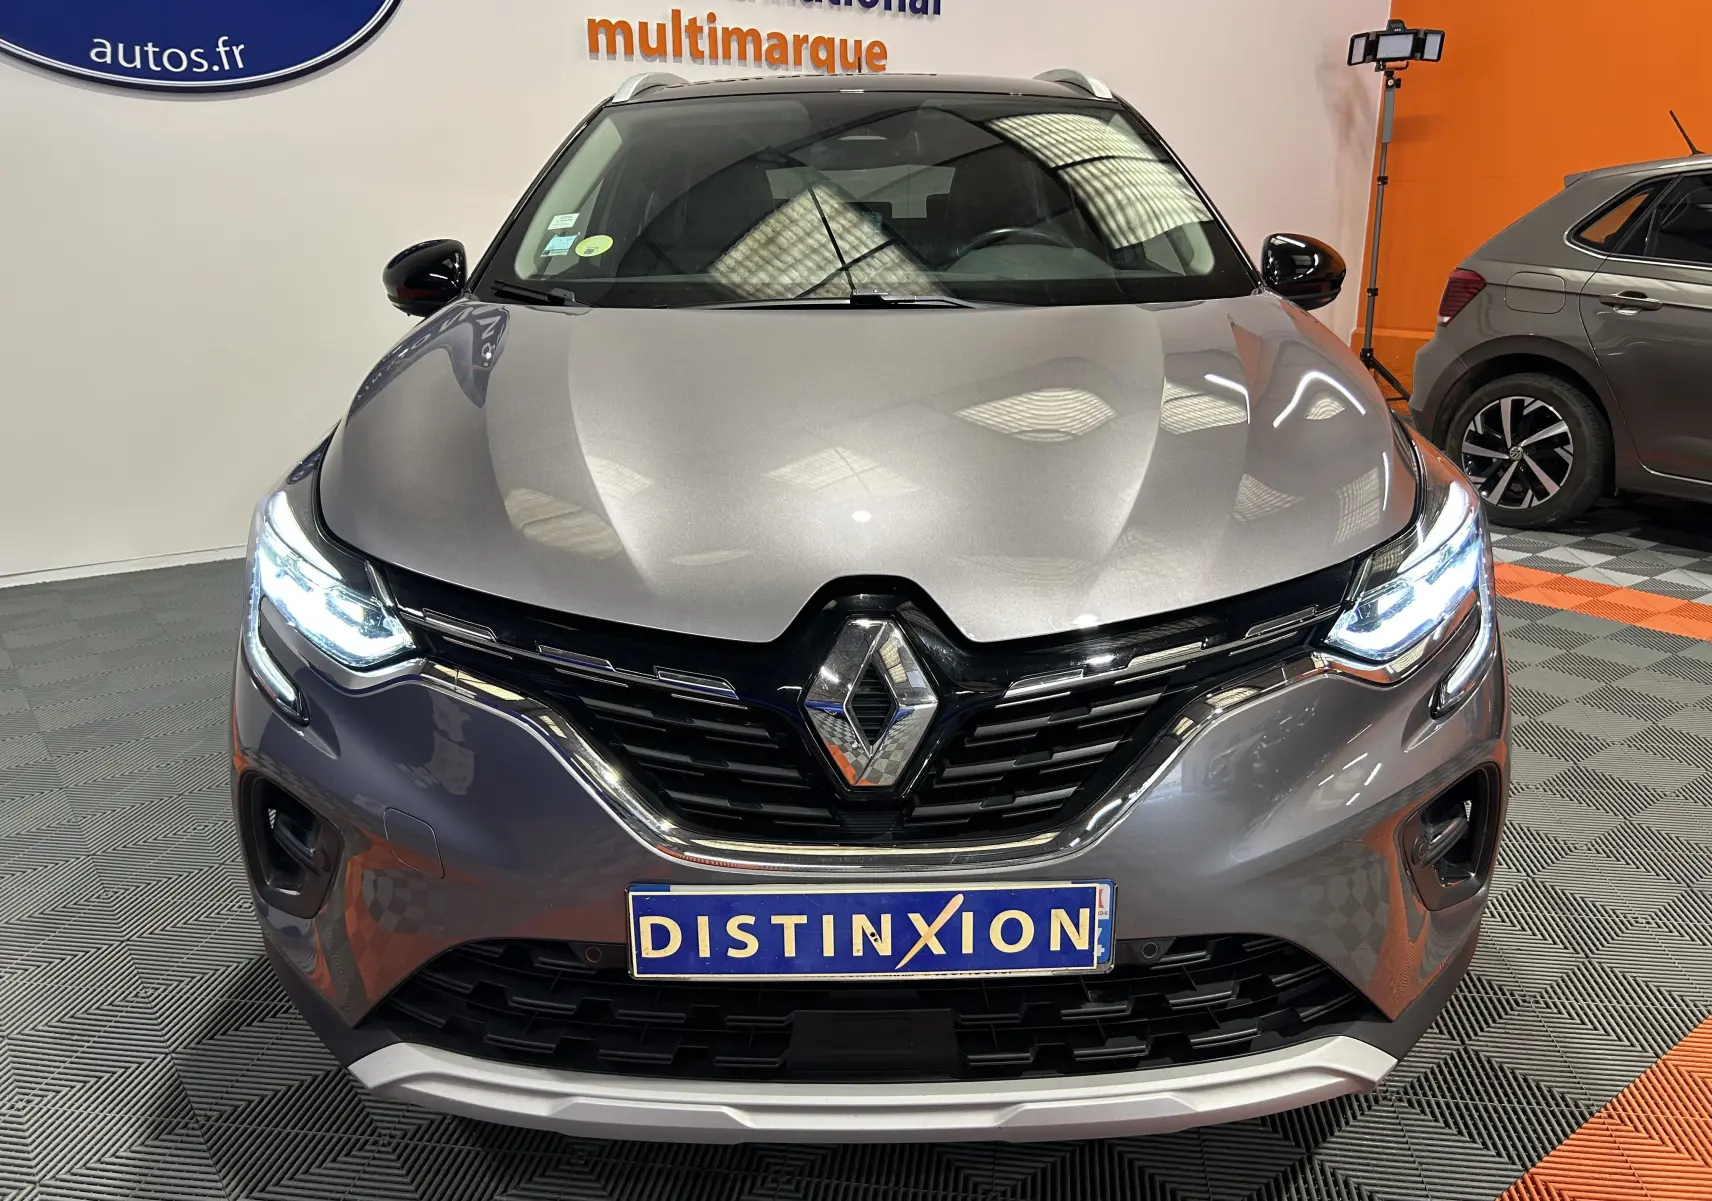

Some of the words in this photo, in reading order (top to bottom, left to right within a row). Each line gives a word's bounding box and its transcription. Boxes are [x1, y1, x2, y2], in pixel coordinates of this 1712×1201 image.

[89, 35, 245, 73] autos.fr
[587, 9, 887, 74] multimarque
[638, 893, 1091, 970] DISTINXION
